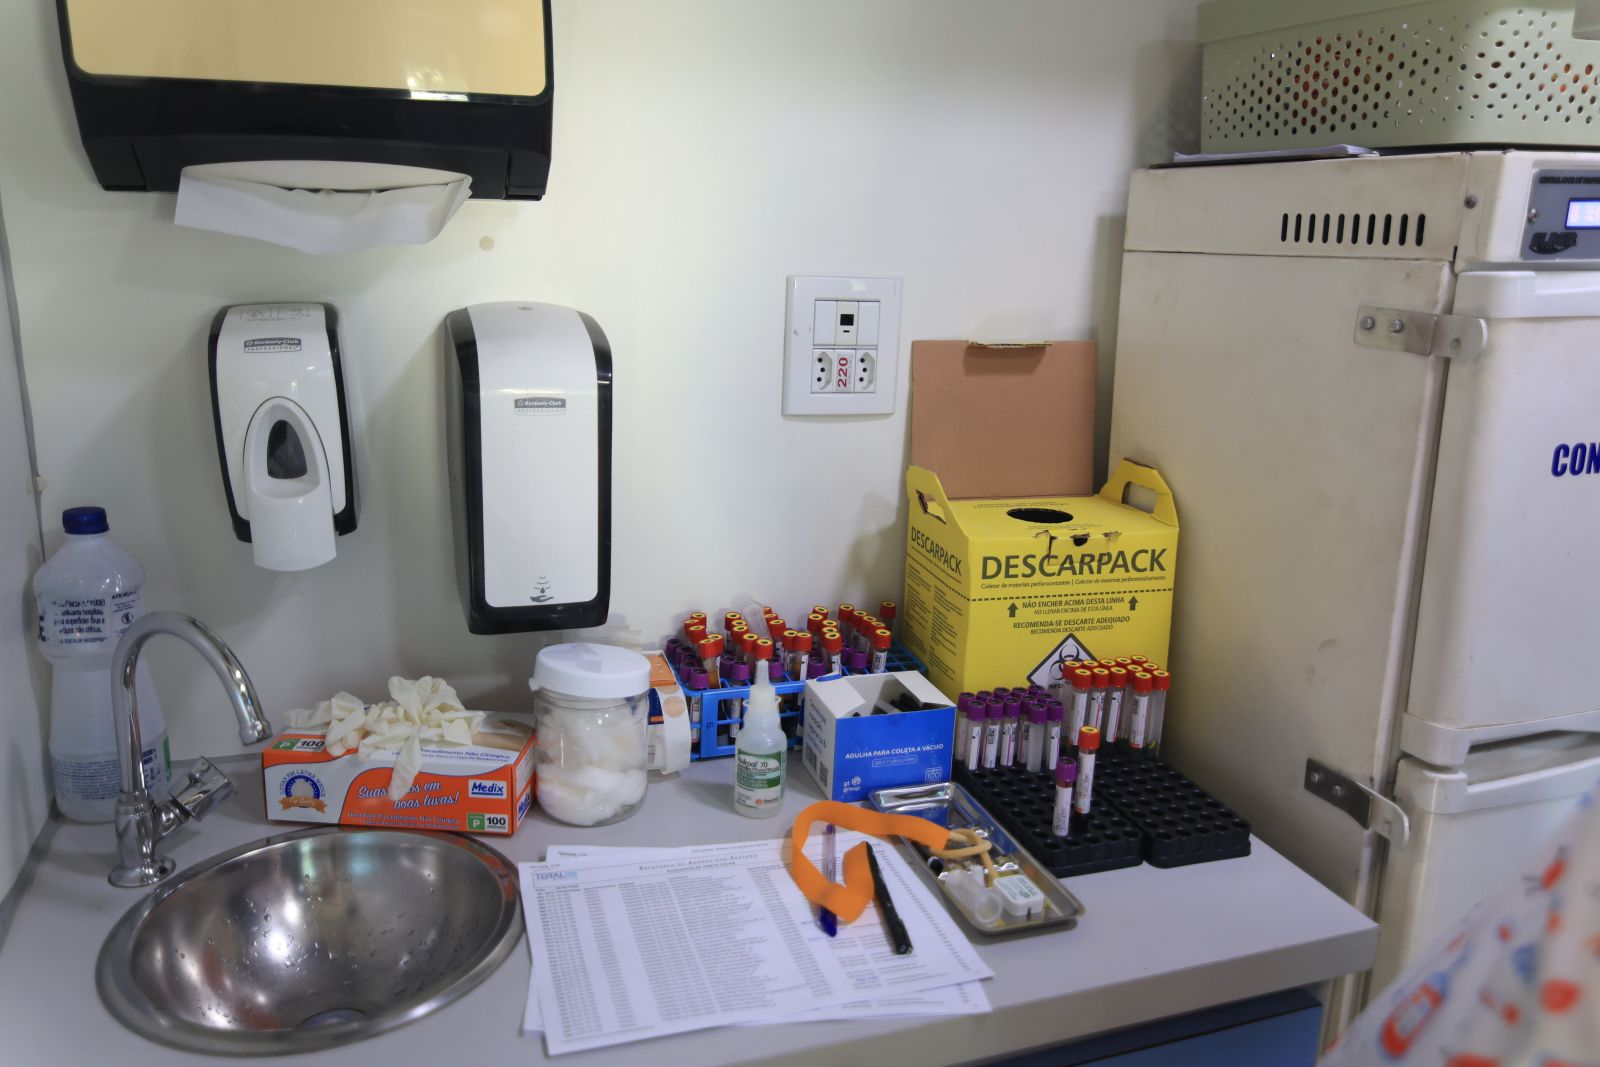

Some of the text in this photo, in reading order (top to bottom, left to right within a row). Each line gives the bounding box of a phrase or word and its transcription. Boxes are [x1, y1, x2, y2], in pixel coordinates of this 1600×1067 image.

[837, 357, 848, 388] 220
[1551, 442, 1600, 477] CON
[911, 526, 962, 577] DESCARPACK
[981, 548, 1167, 580] DESCARPACK
[1022, 600, 1037, 608] NÃO
[1013, 616, 1130, 629] RECOMENDA-SE DESCARTE ADEQUADO
[420, 747, 464, 755] rocedimento
[845, 751, 872, 759] AGULHA
[891, 747, 915, 755] COLETA
[921, 743, 944, 751] VÁCUO
[358, 785, 388, 799] Suas
[424, 781, 441, 792] em
[471, 782, 504, 793] Medix
[423, 791, 460, 807] luvas!
[473, 819, 480, 828] P
[486, 816, 506, 826] 100
